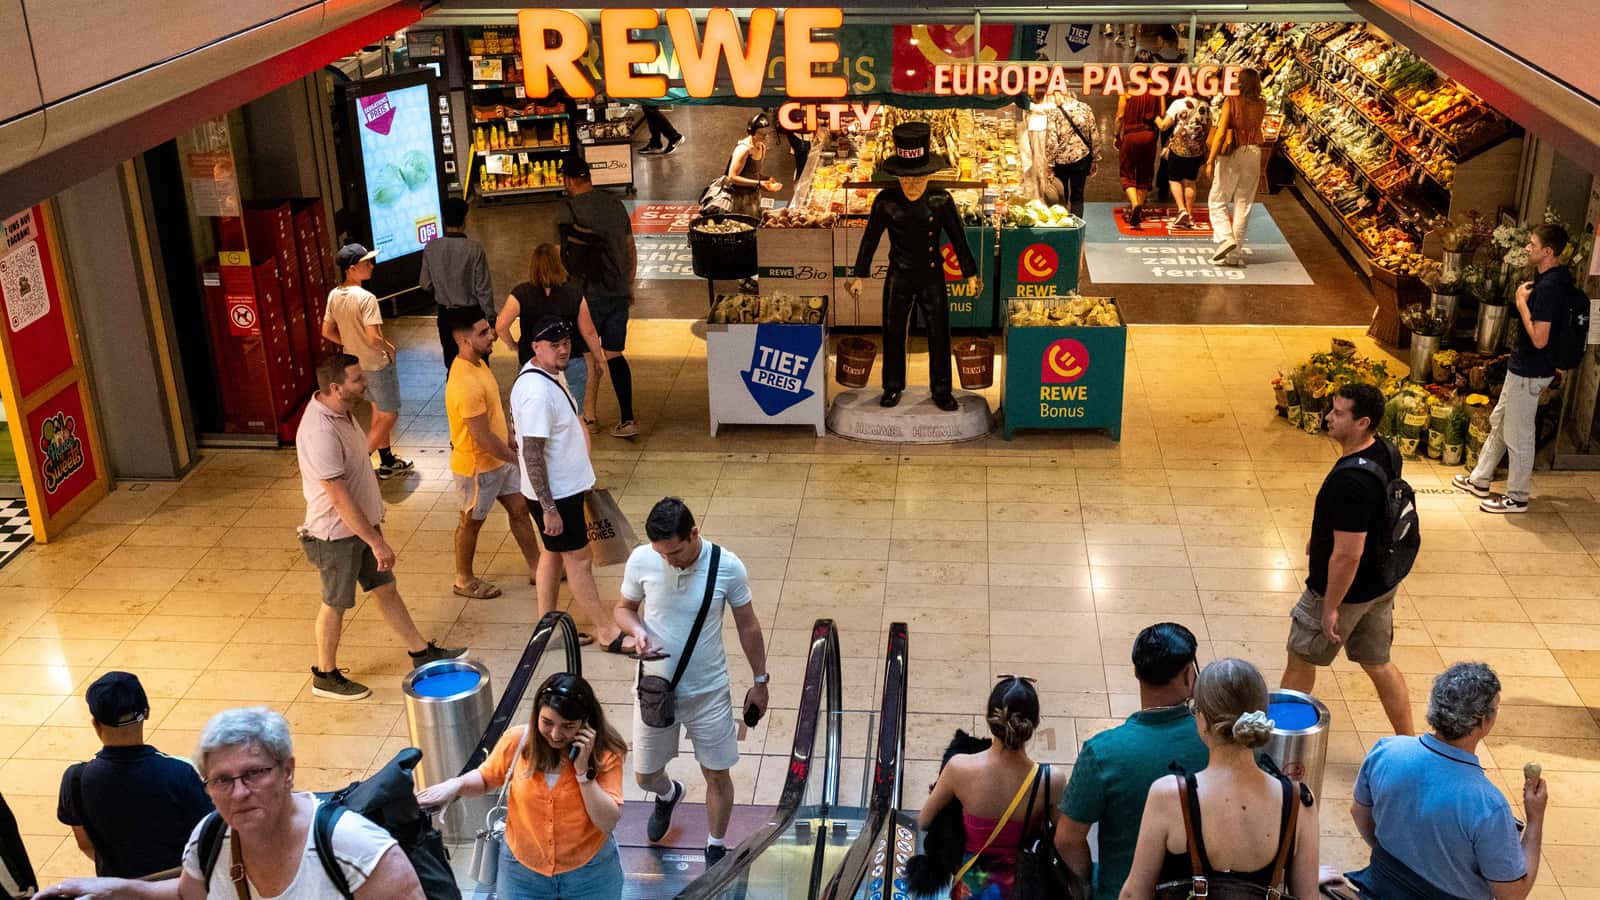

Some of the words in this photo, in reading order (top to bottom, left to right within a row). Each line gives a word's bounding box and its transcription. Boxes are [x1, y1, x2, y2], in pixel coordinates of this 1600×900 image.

[517, 7, 848, 99] REWE
[934, 63, 1068, 97] EUROPA
[1082, 63, 1241, 97] PASSAGE
[778, 101, 880, 131] CITY
[769, 268, 793, 277] REWE
[795, 265, 827, 280] Bio
[1151, 266, 1246, 280] fertig
[1016, 284, 1057, 297] REWE
[759, 345, 809, 376] TIEF
[758, 371, 796, 391] PREIS
[1040, 385, 1088, 401] REWE
[1040, 402, 1085, 418] Bonus
[45, 454, 81, 489] Sweets
